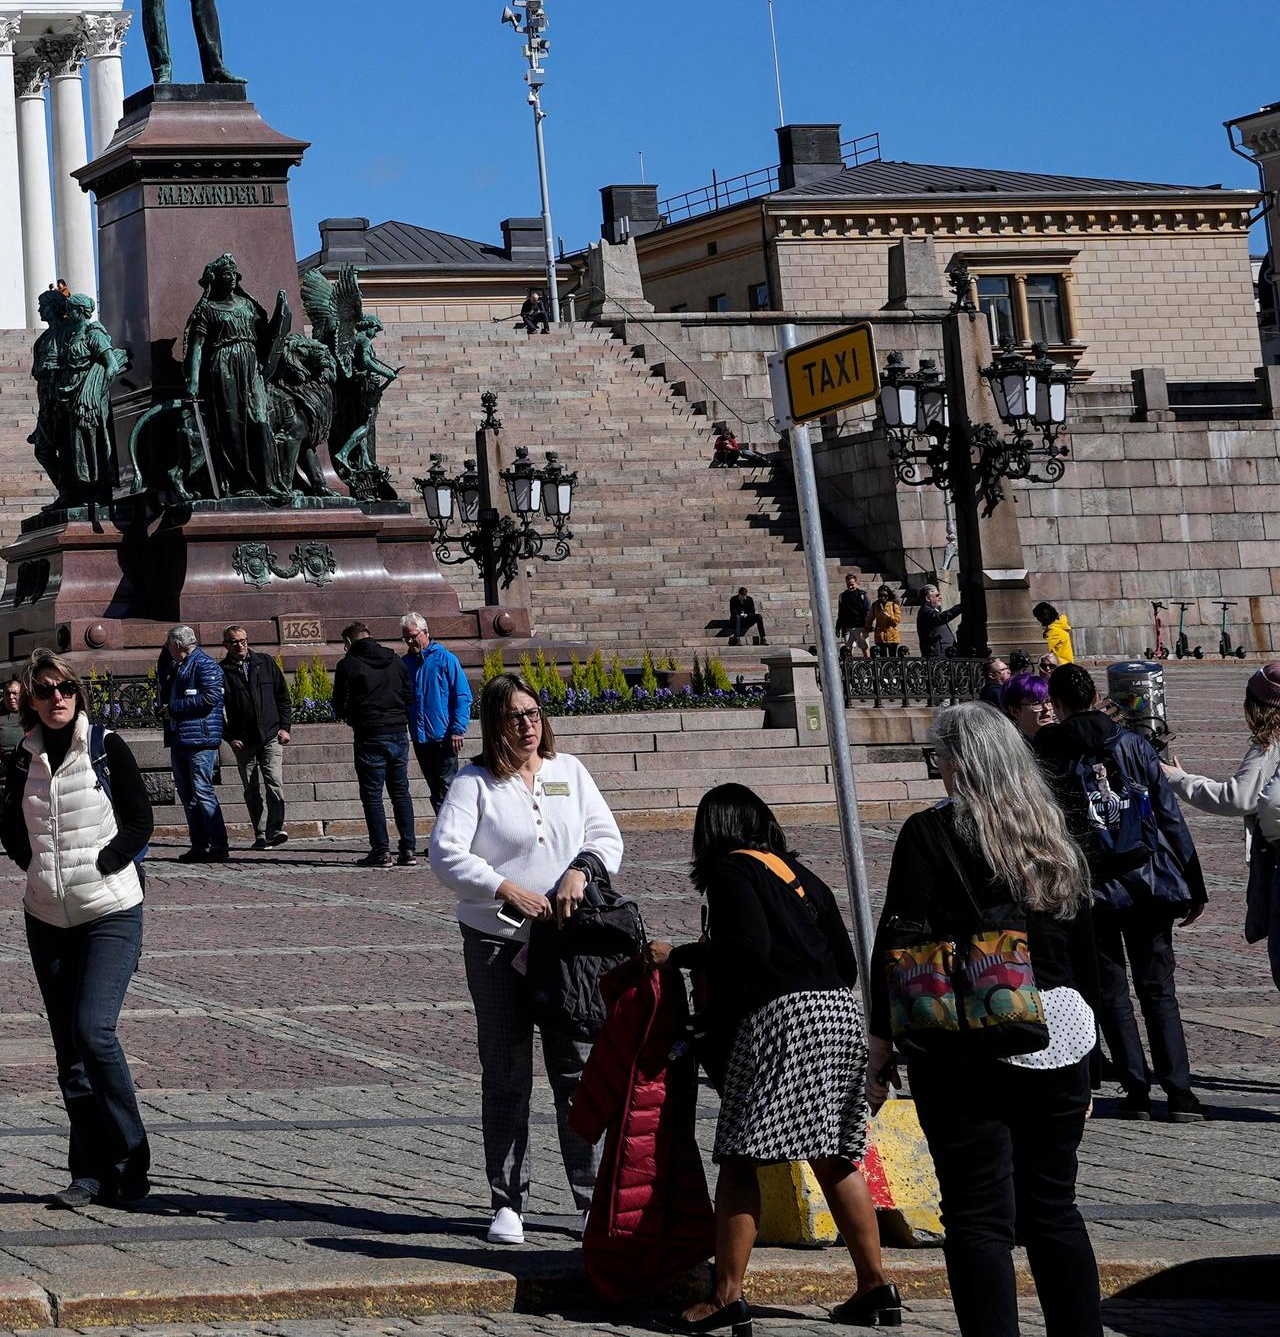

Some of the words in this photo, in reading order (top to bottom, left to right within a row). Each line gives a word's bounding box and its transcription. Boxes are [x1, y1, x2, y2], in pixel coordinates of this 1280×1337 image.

[158, 185, 259, 205] ALEXANDER
[261, 184, 274, 204] II
[802, 347, 860, 396] TAXI
